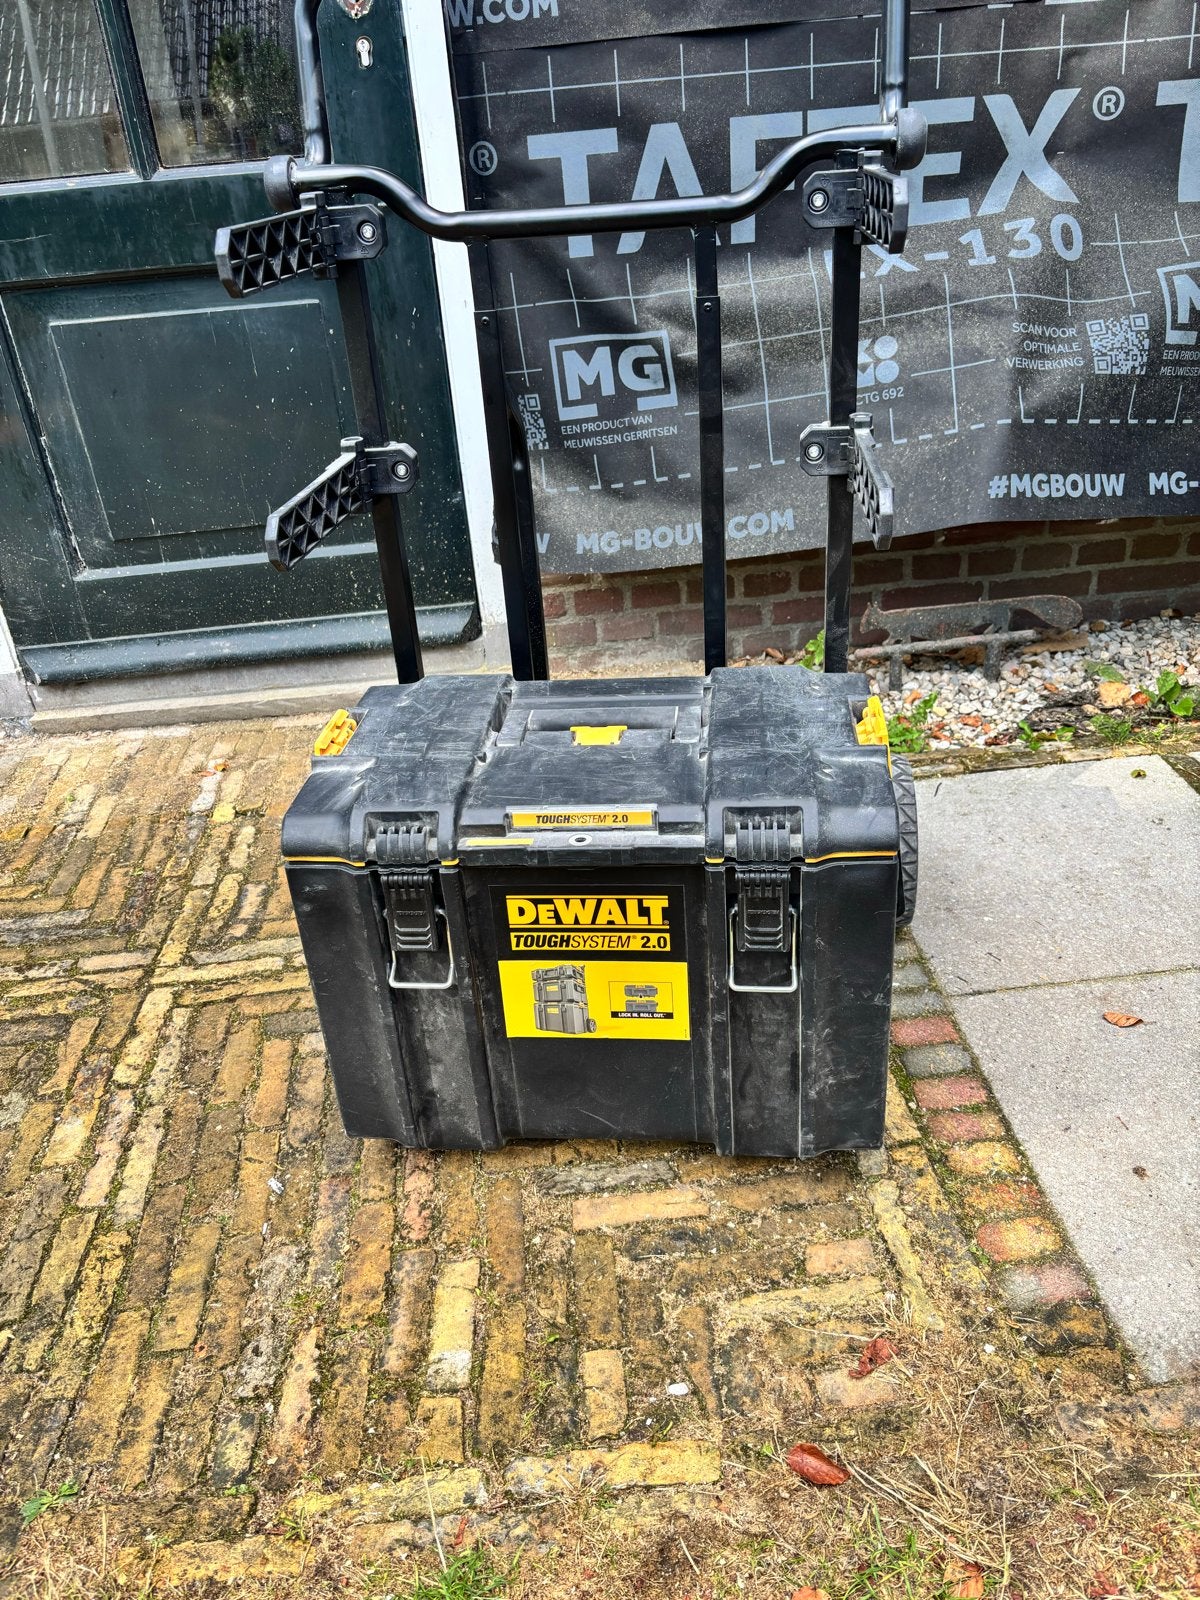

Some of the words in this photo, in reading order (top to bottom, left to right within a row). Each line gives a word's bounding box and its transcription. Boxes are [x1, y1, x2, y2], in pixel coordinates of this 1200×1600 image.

[823, 213, 1084, 285] X-130
[1012, 322, 1042, 336] SCAN
[1043, 326, 1078, 338] VOOR
[1023, 340, 1082, 354] OPTIMALE
[562, 344, 665, 401] MG
[1006, 357, 1085, 371] VERWERKING
[882, 386, 905, 401] 692
[561, 425, 580, 435] EEN
[582, 417, 630, 432] PRODUCT
[631, 414, 653, 426] VAN
[564, 434, 622, 449] MEUWISSEN
[623, 425, 678, 442] GERRITSEN
[988, 473, 1125, 498] #MGBOUW
[576, 508, 794, 555] MG-BOUCOM
[612, 814, 629, 823] 2.0
[641, 935, 668, 949] 2.0
